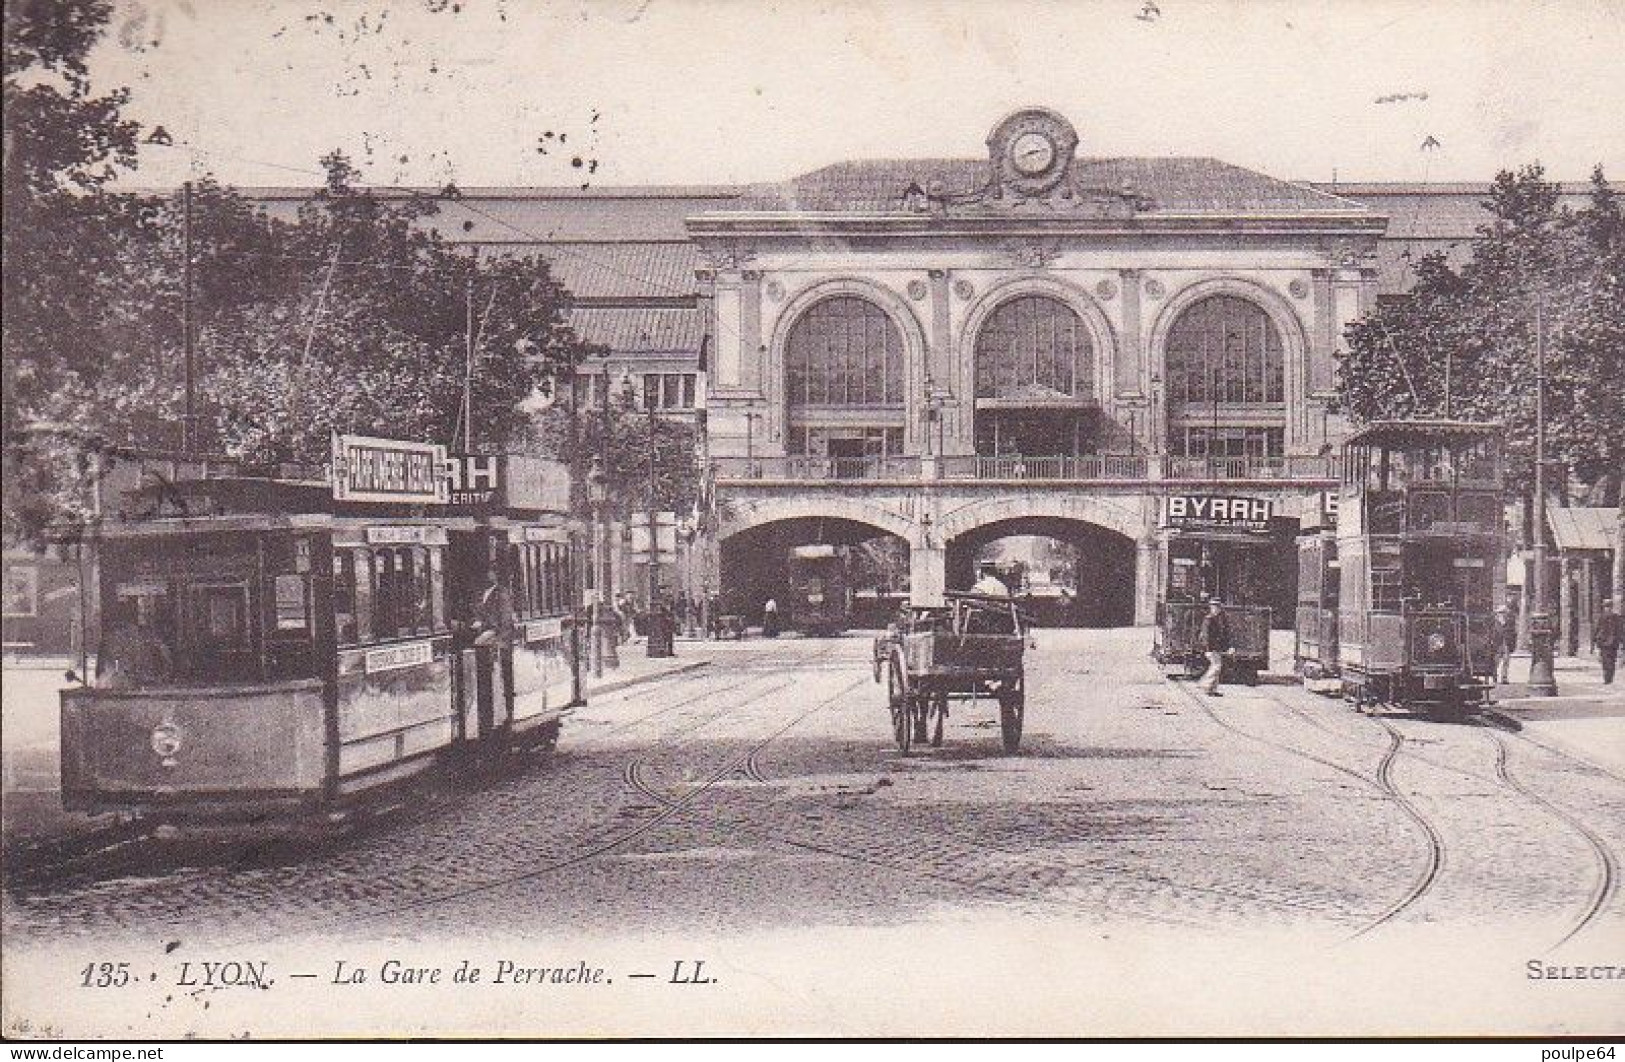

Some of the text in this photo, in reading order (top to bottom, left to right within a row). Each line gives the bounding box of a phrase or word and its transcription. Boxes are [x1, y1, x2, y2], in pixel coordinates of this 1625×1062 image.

[331, 960, 368, 984] La
[380, 960, 442, 984] Gare
[453, 960, 481, 984] de
[492, 960, 613, 984] Perrache.
[668, 960, 719, 984] LL.
